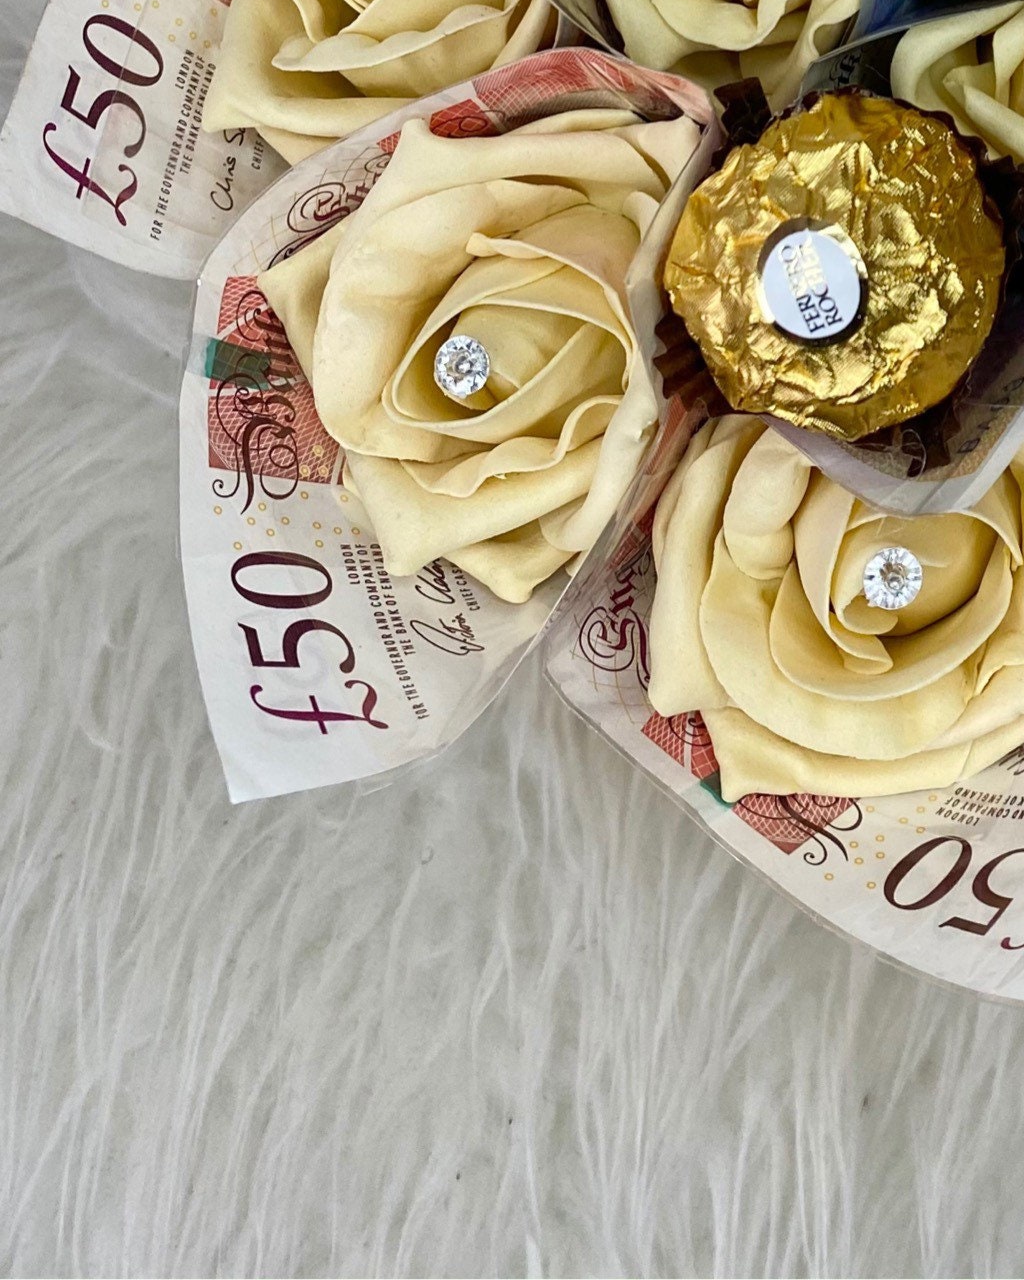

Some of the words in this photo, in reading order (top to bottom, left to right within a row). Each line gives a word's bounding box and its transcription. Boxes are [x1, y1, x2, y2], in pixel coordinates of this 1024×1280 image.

[175, 48, 195, 90] LONDON
[194, 55, 206, 69] OF
[180, 67, 202, 117] COMPANY
[42, 13, 165, 227] £50
[174, 119, 188, 144] AND
[185, 125, 201, 153] BANK
[180, 154, 194, 175] THE
[251, 139, 265, 170] CHIEF
[160, 140, 183, 196] GOVERNOR
[155, 196, 169, 218] THE
[150, 219, 164, 241] FOR
[355, 543, 368, 556] OF
[340, 544, 361, 586] LONDON
[359, 558, 382, 608] COMPANY
[383, 593, 397, 607] OF
[459, 587, 481, 612] CHIEF
[373, 611, 391, 631] AND
[388, 608, 408, 635] BANK
[230, 549, 390, 735] £50
[400, 638, 416, 656] THE
[381, 634, 411, 682] GOVERNOR
[402, 683, 420, 701] THE
[412, 702, 430, 720] FOR
[944, 797, 959, 807] OF
[954, 787, 1001, 804] ENGLAND
[1003, 794, 1016, 806] OF
[935, 806, 981, 827] LONDON
[960, 800, 1010, 819] COMPANY
